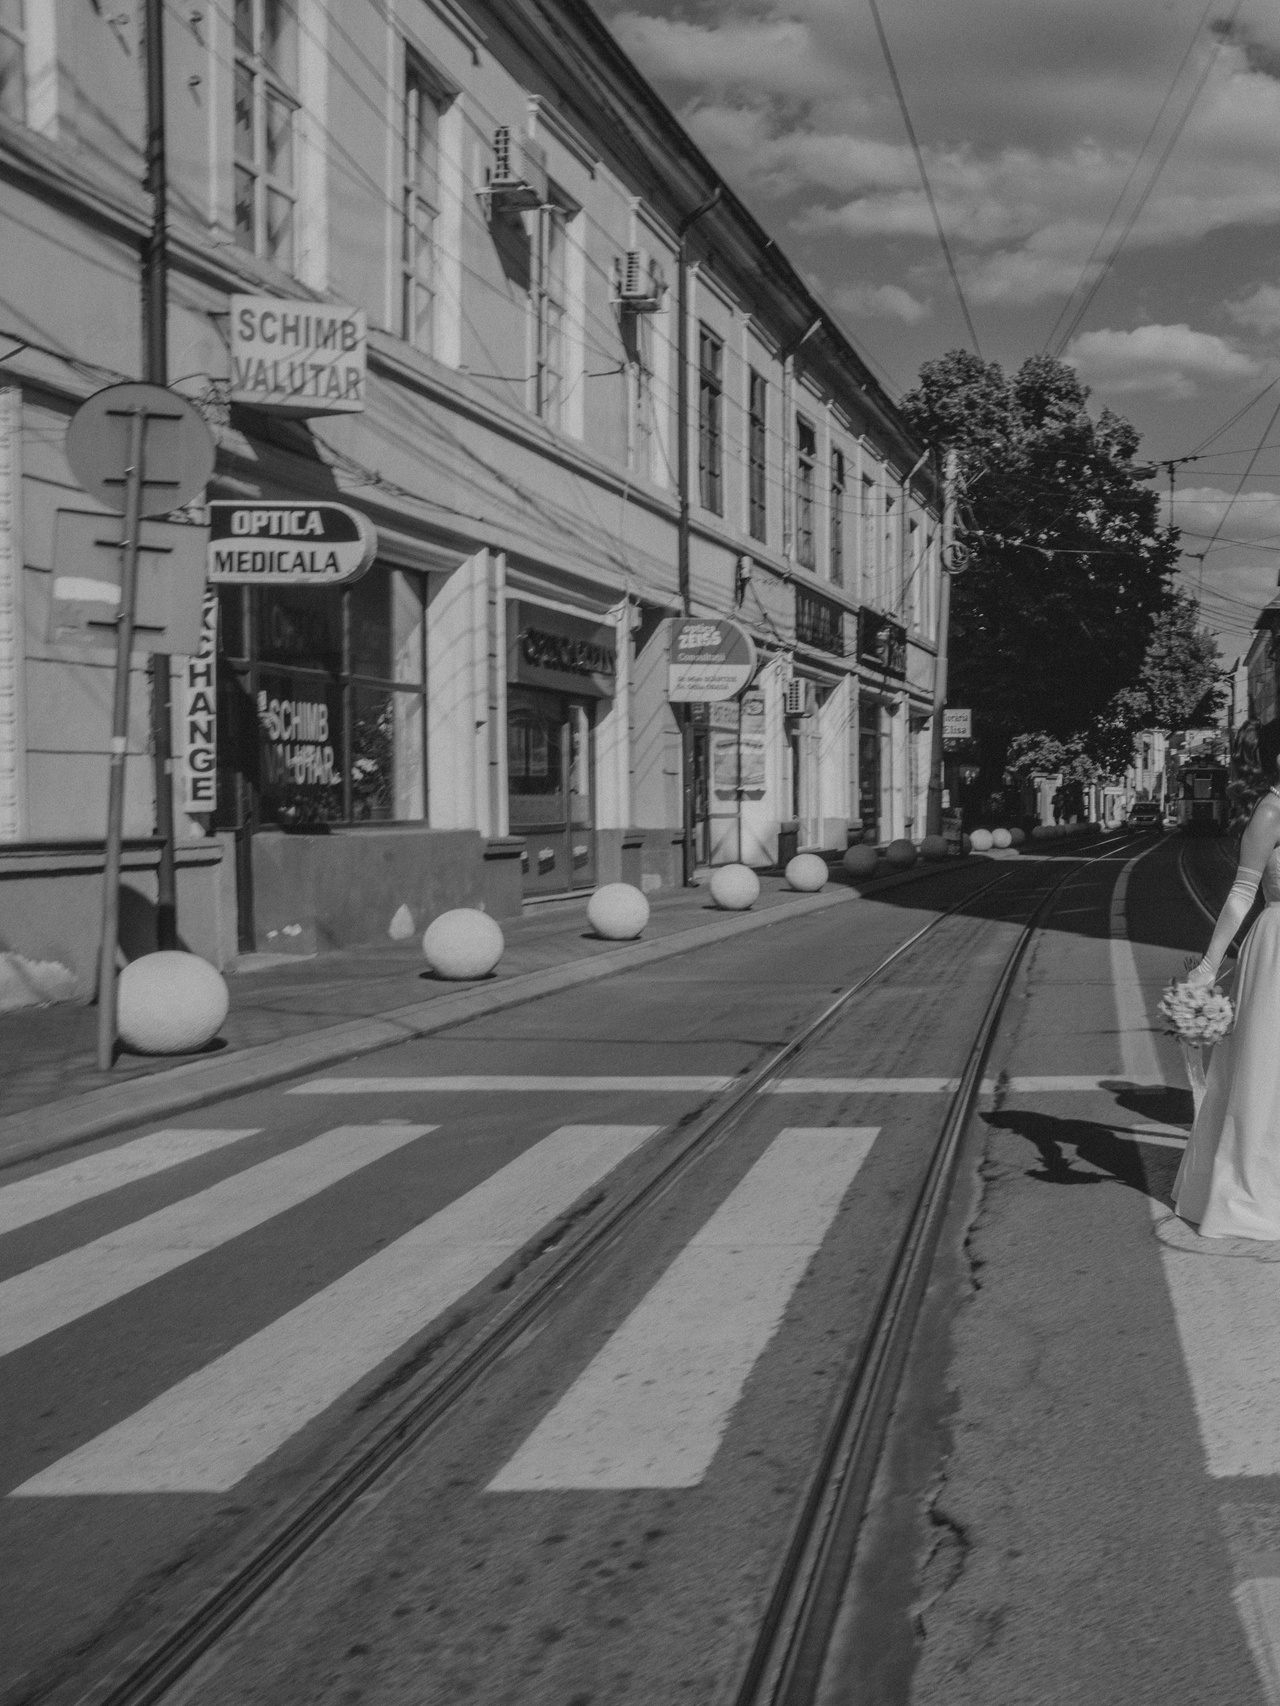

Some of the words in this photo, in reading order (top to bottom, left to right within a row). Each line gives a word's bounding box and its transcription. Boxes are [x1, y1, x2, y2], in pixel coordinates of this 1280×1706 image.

[238, 308, 358, 352] SCHIMB
[232, 356, 361, 400] VALUTAR
[231, 510, 325, 536] OPTICA
[214, 551, 341, 573] MEDICALA
[678, 631, 722, 650] ZEISS
[269, 698, 329, 742] SCHIMB
